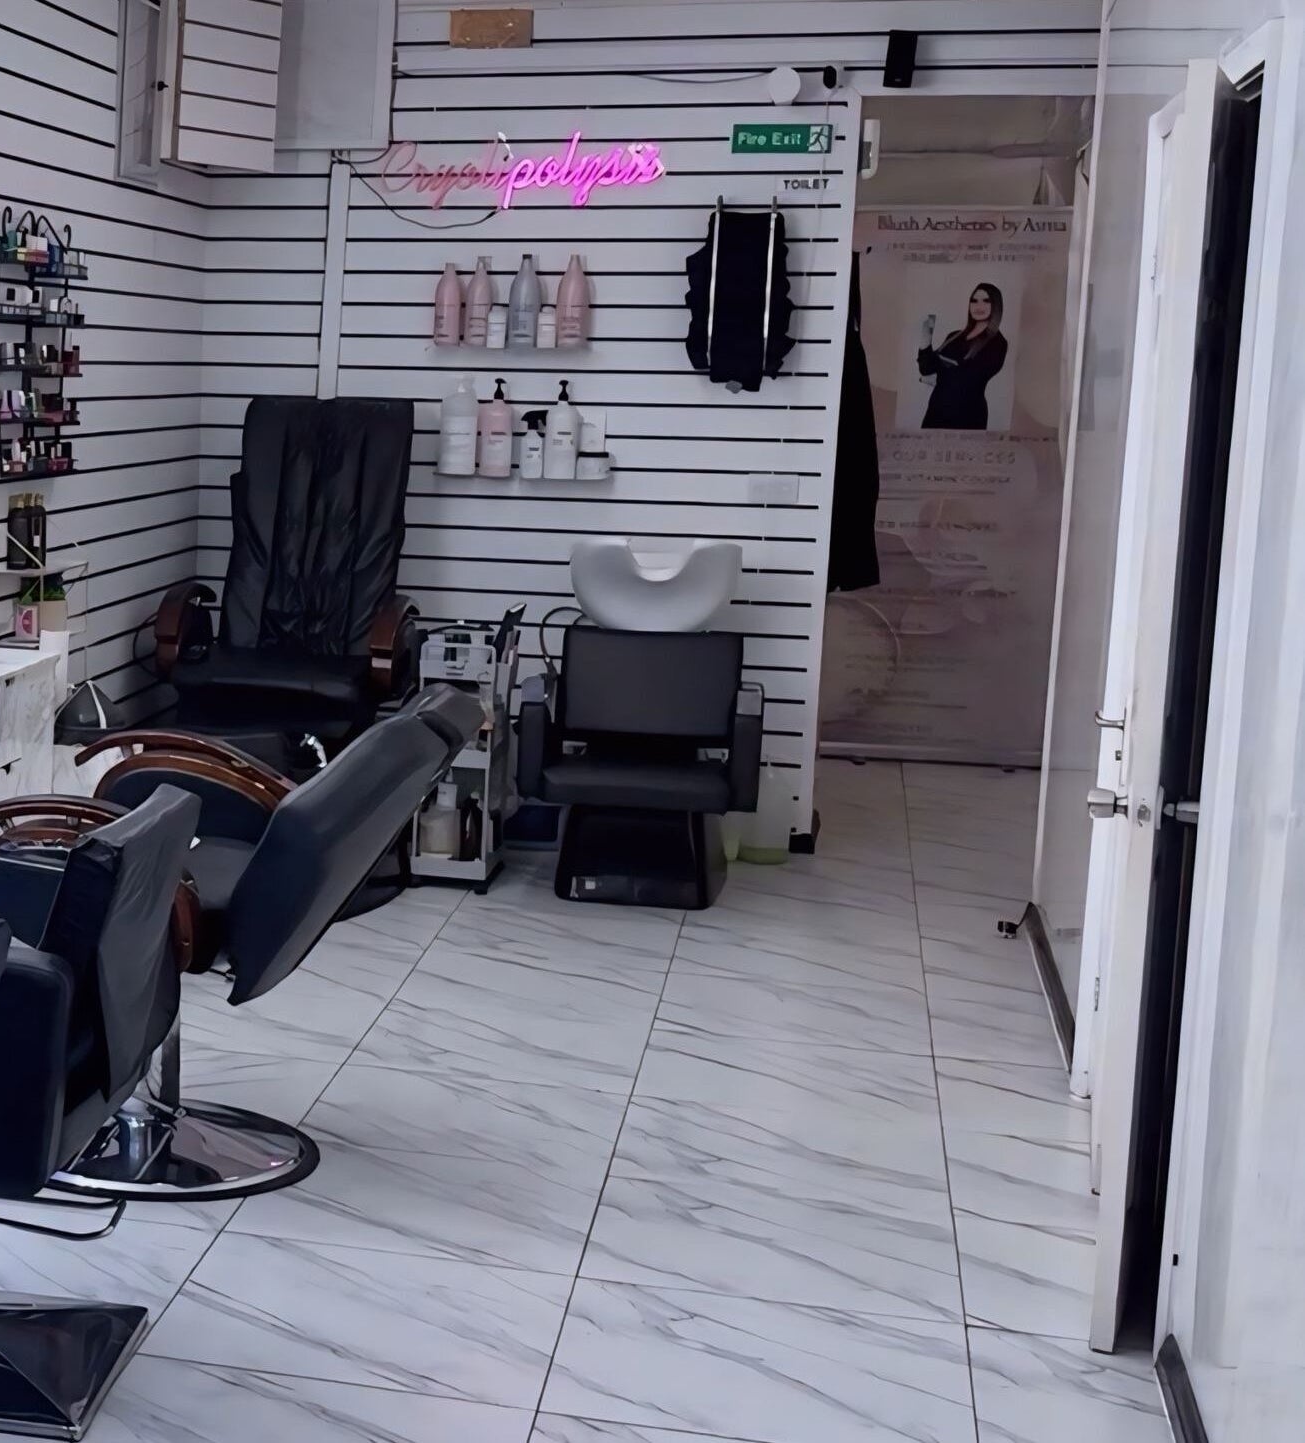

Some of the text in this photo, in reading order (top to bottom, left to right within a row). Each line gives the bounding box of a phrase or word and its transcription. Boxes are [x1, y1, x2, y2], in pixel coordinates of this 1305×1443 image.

[737, 131, 767, 146] Fire
[782, 178, 830, 191] TOILET
[1002, 215, 1020, 238] by
